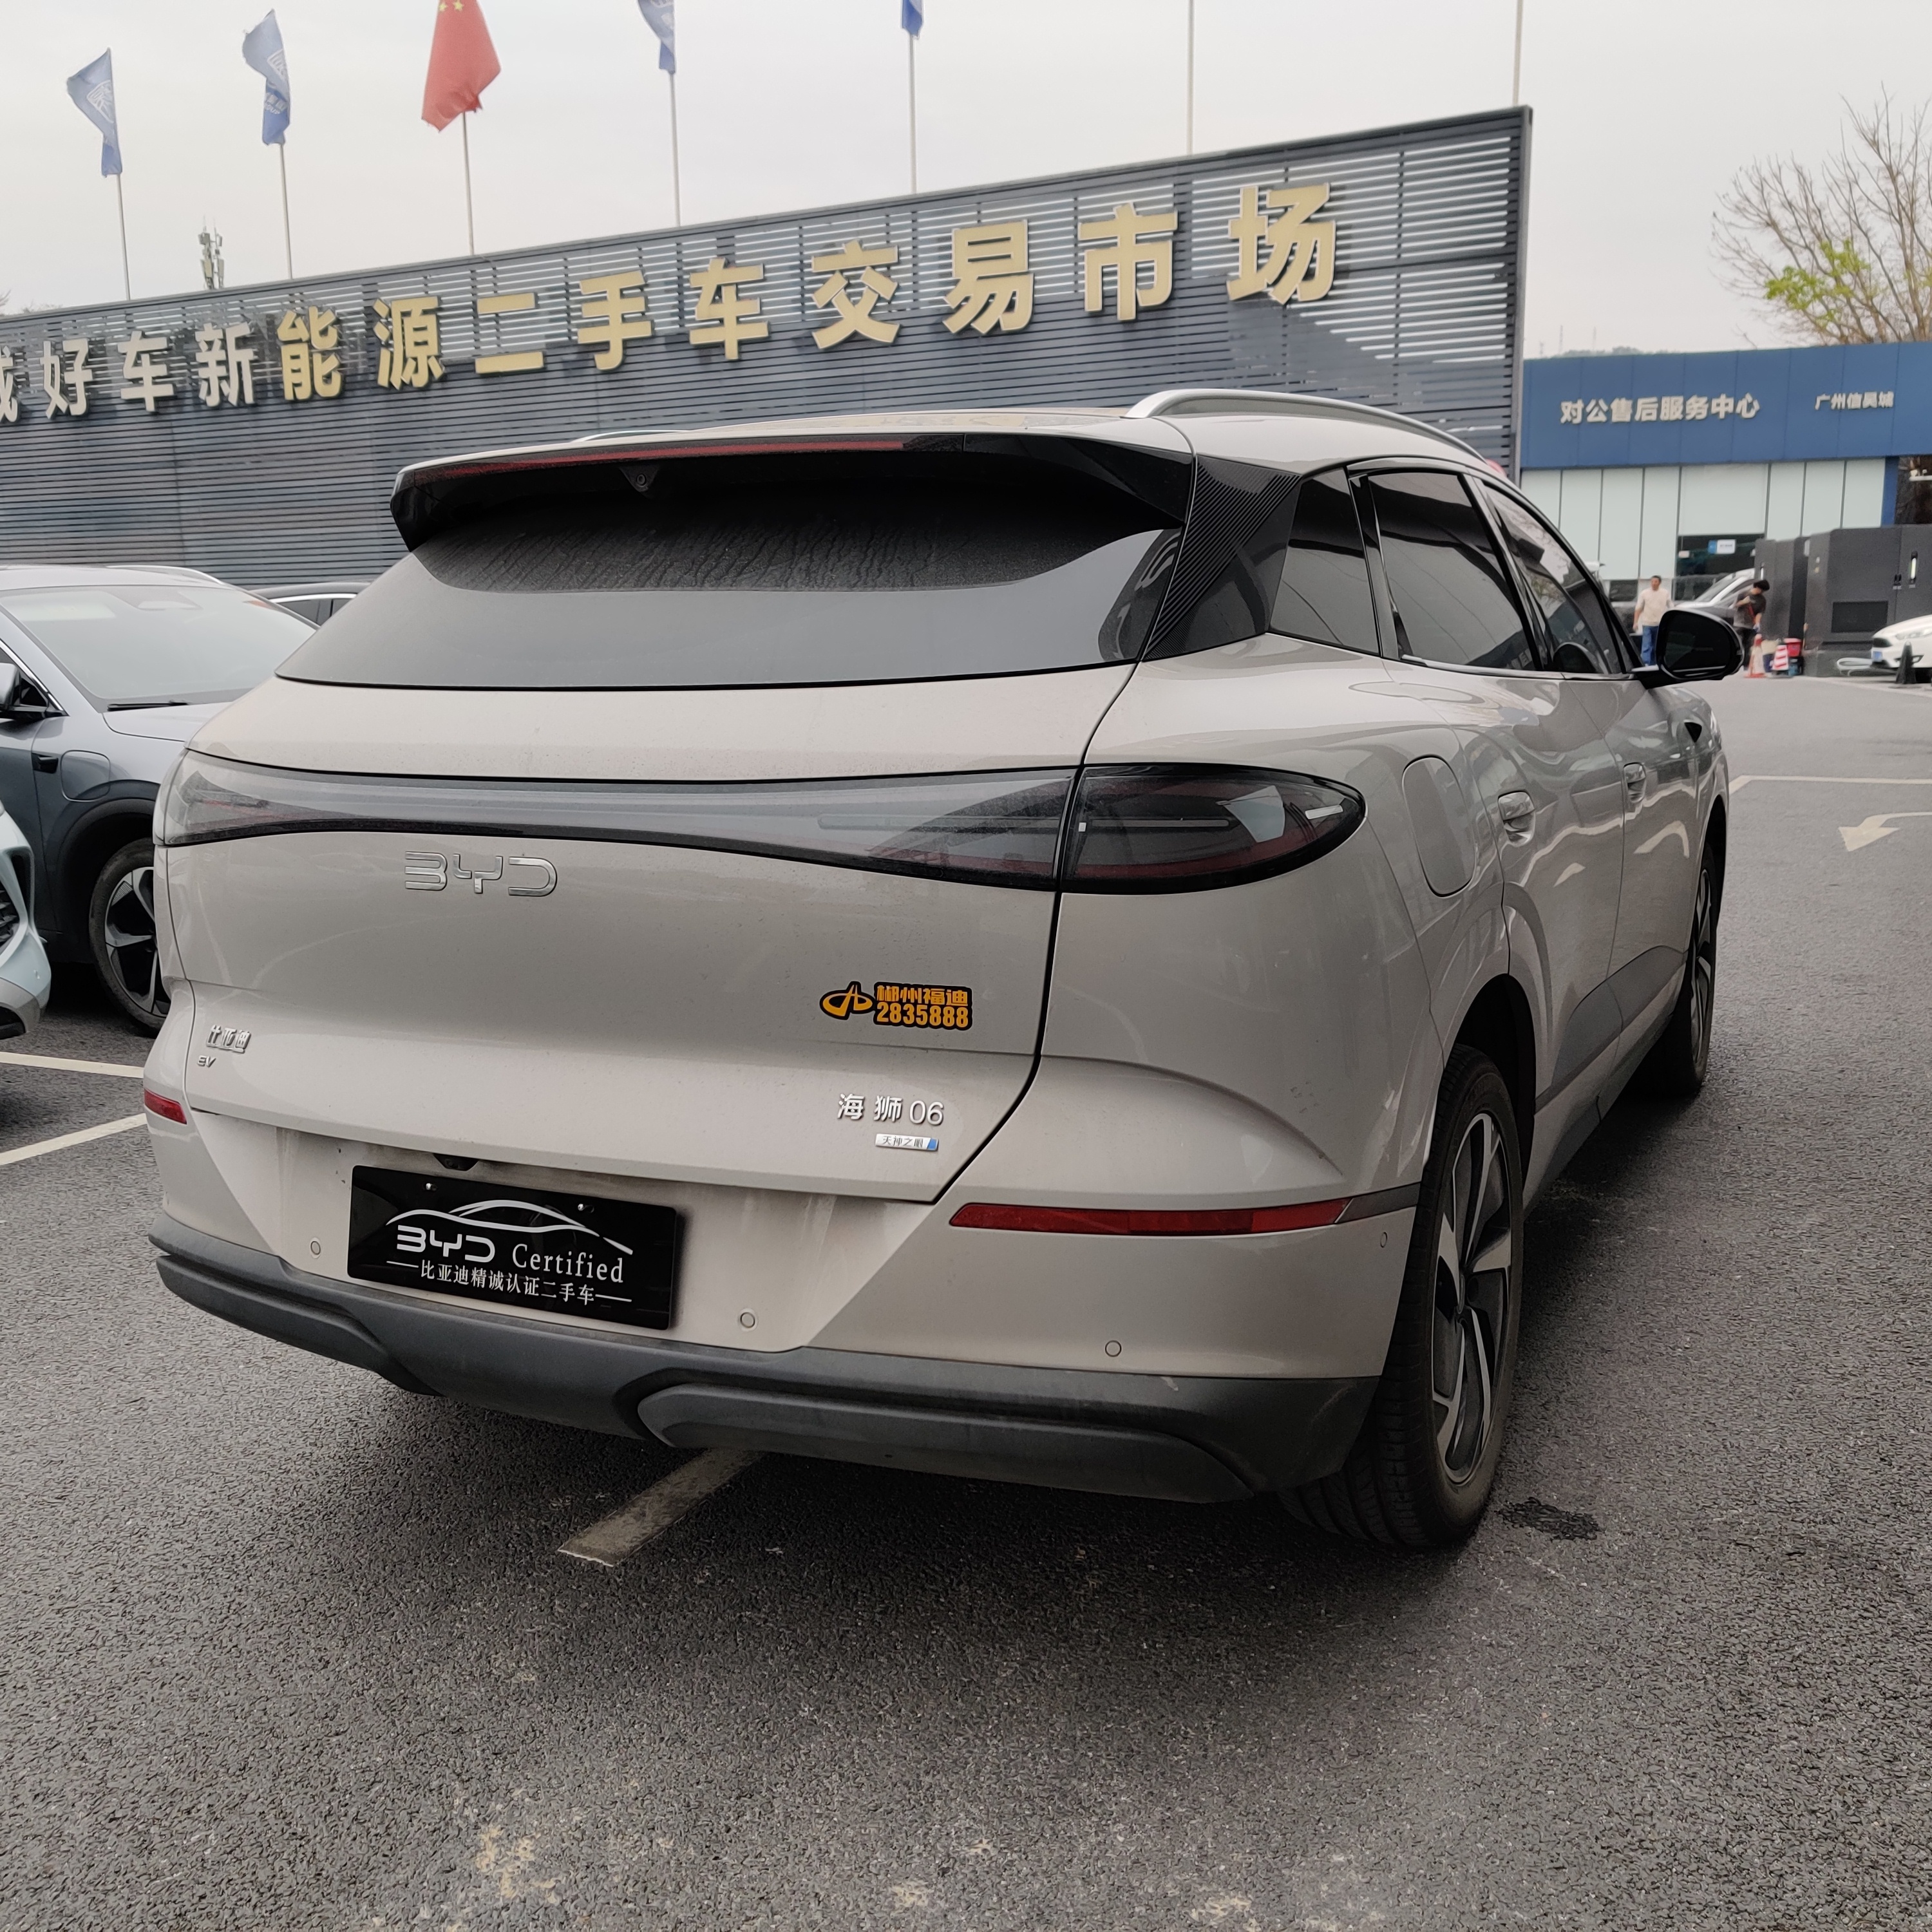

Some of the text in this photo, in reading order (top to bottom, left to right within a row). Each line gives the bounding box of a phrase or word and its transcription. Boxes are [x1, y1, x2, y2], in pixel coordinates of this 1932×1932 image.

[1560, 393, 1760, 424] 对公售后服务中心
[405, 851, 558, 896] BYD
[876, 1001, 969, 1028] 2835888
[197, 1055, 216, 1067] EV
[397, 1225, 624, 1283] BYD Certified
[421, 1259, 595, 1306] 比亚迪精诚认证二手车
